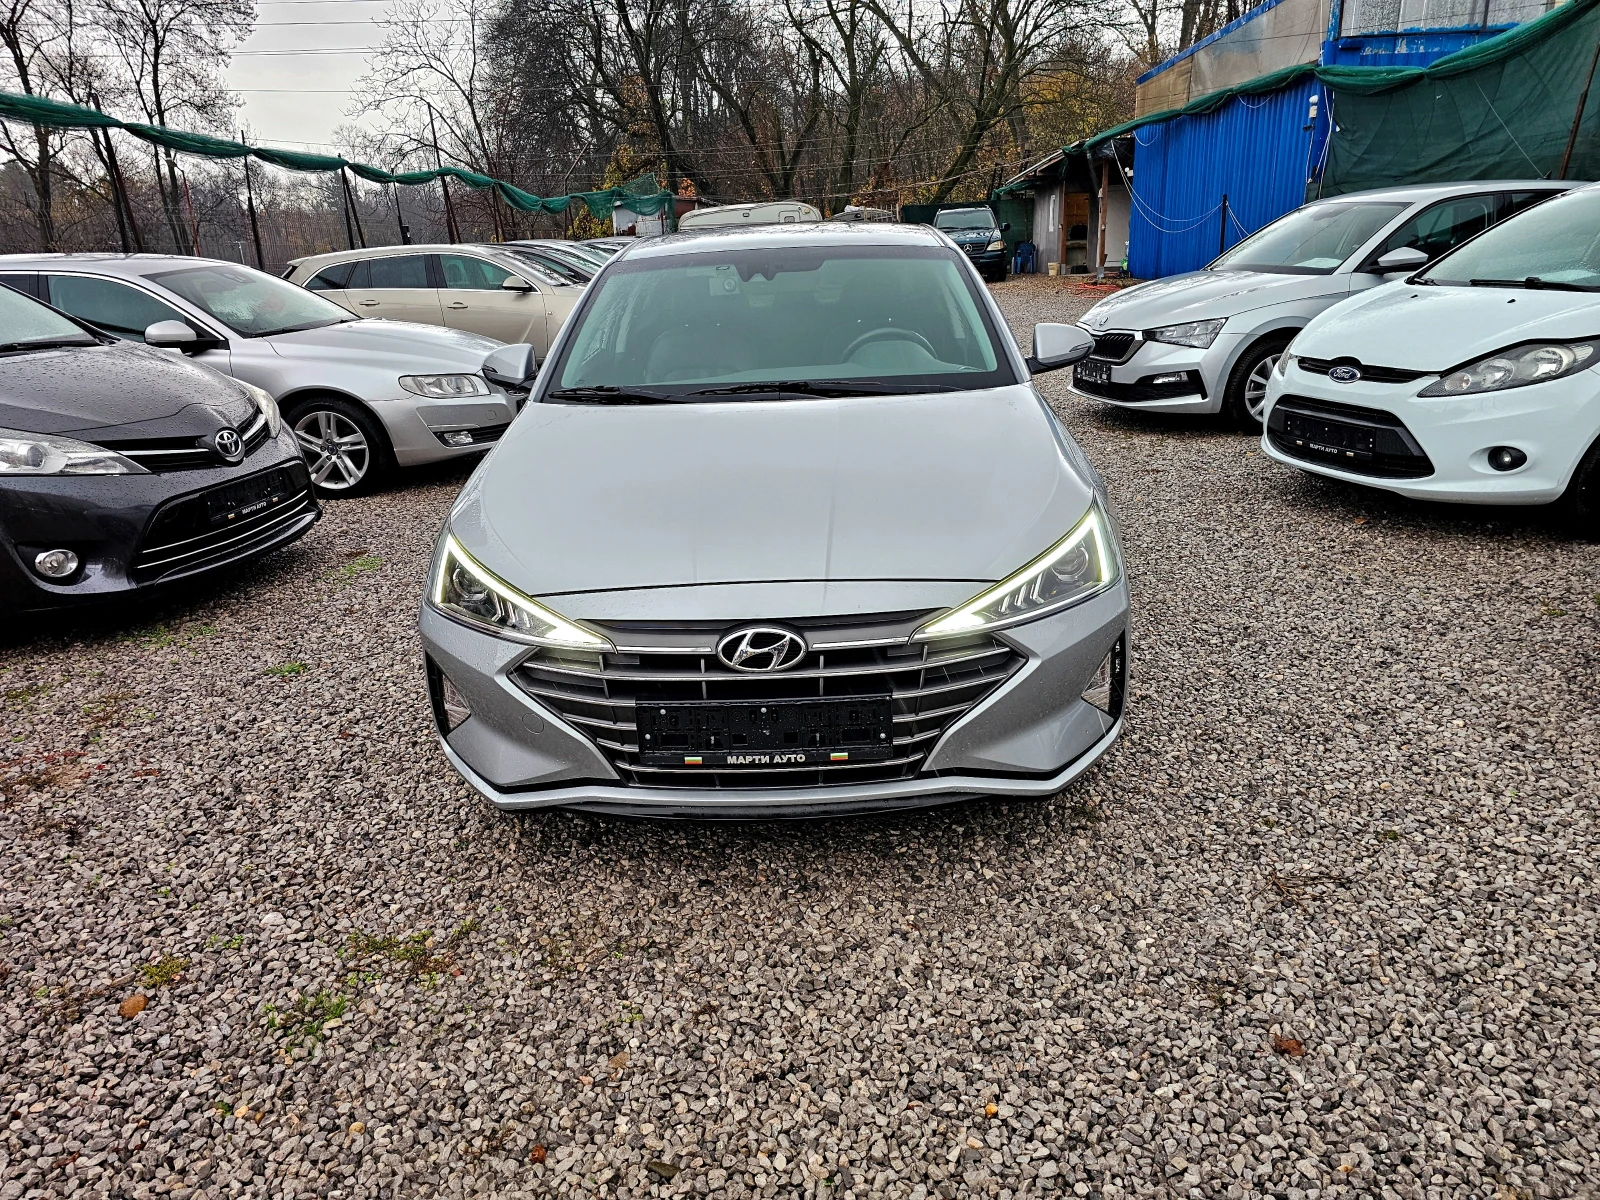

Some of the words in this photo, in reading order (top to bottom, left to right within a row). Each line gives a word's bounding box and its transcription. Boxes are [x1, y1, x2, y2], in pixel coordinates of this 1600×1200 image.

[1333, 368, 1352, 379] Ford
[726, 755, 770, 764] МАРТИ
[773, 754, 806, 763] АУТО
